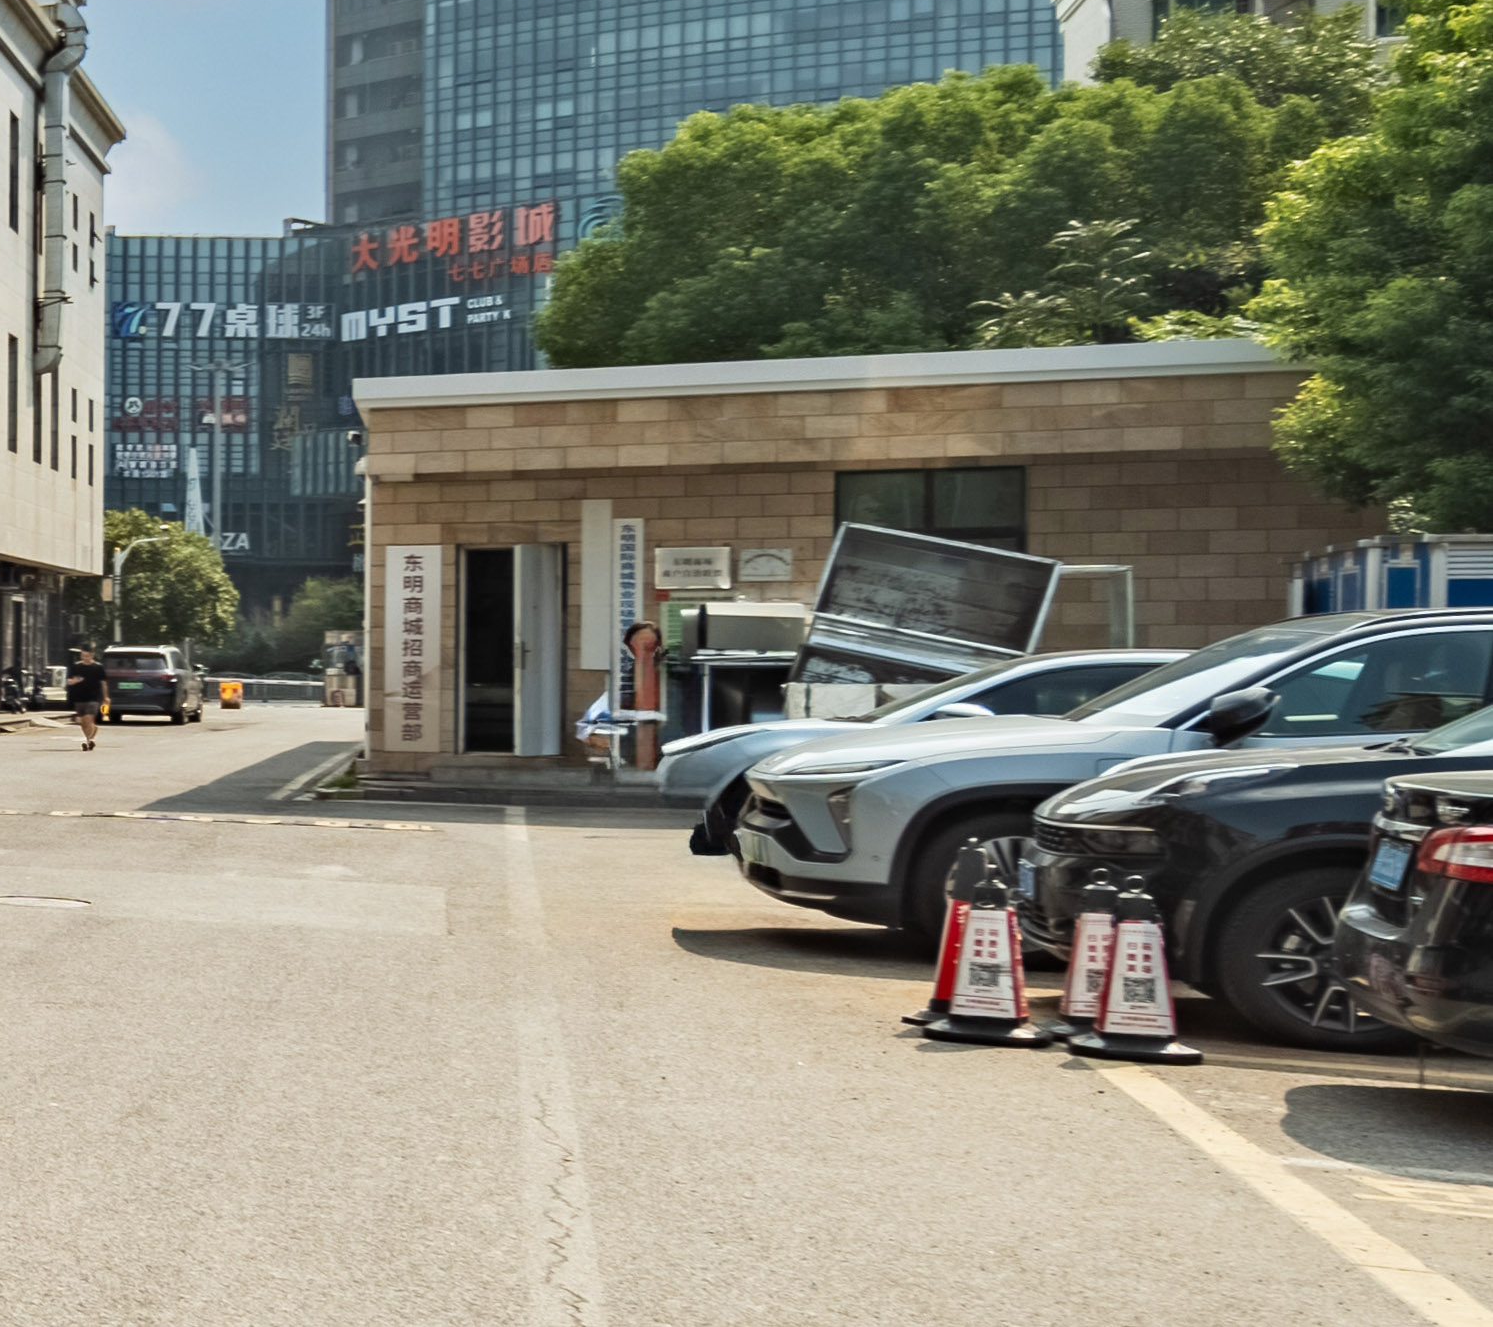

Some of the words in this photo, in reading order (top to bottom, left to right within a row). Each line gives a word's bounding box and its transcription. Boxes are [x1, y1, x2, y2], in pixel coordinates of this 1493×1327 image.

[351, 203, 555, 272] 大光明影城
[466, 296, 494, 308] CLUB
[467, 311, 499, 324] PARTY
[401, 554, 424, 742] 东明商城招商运营部
